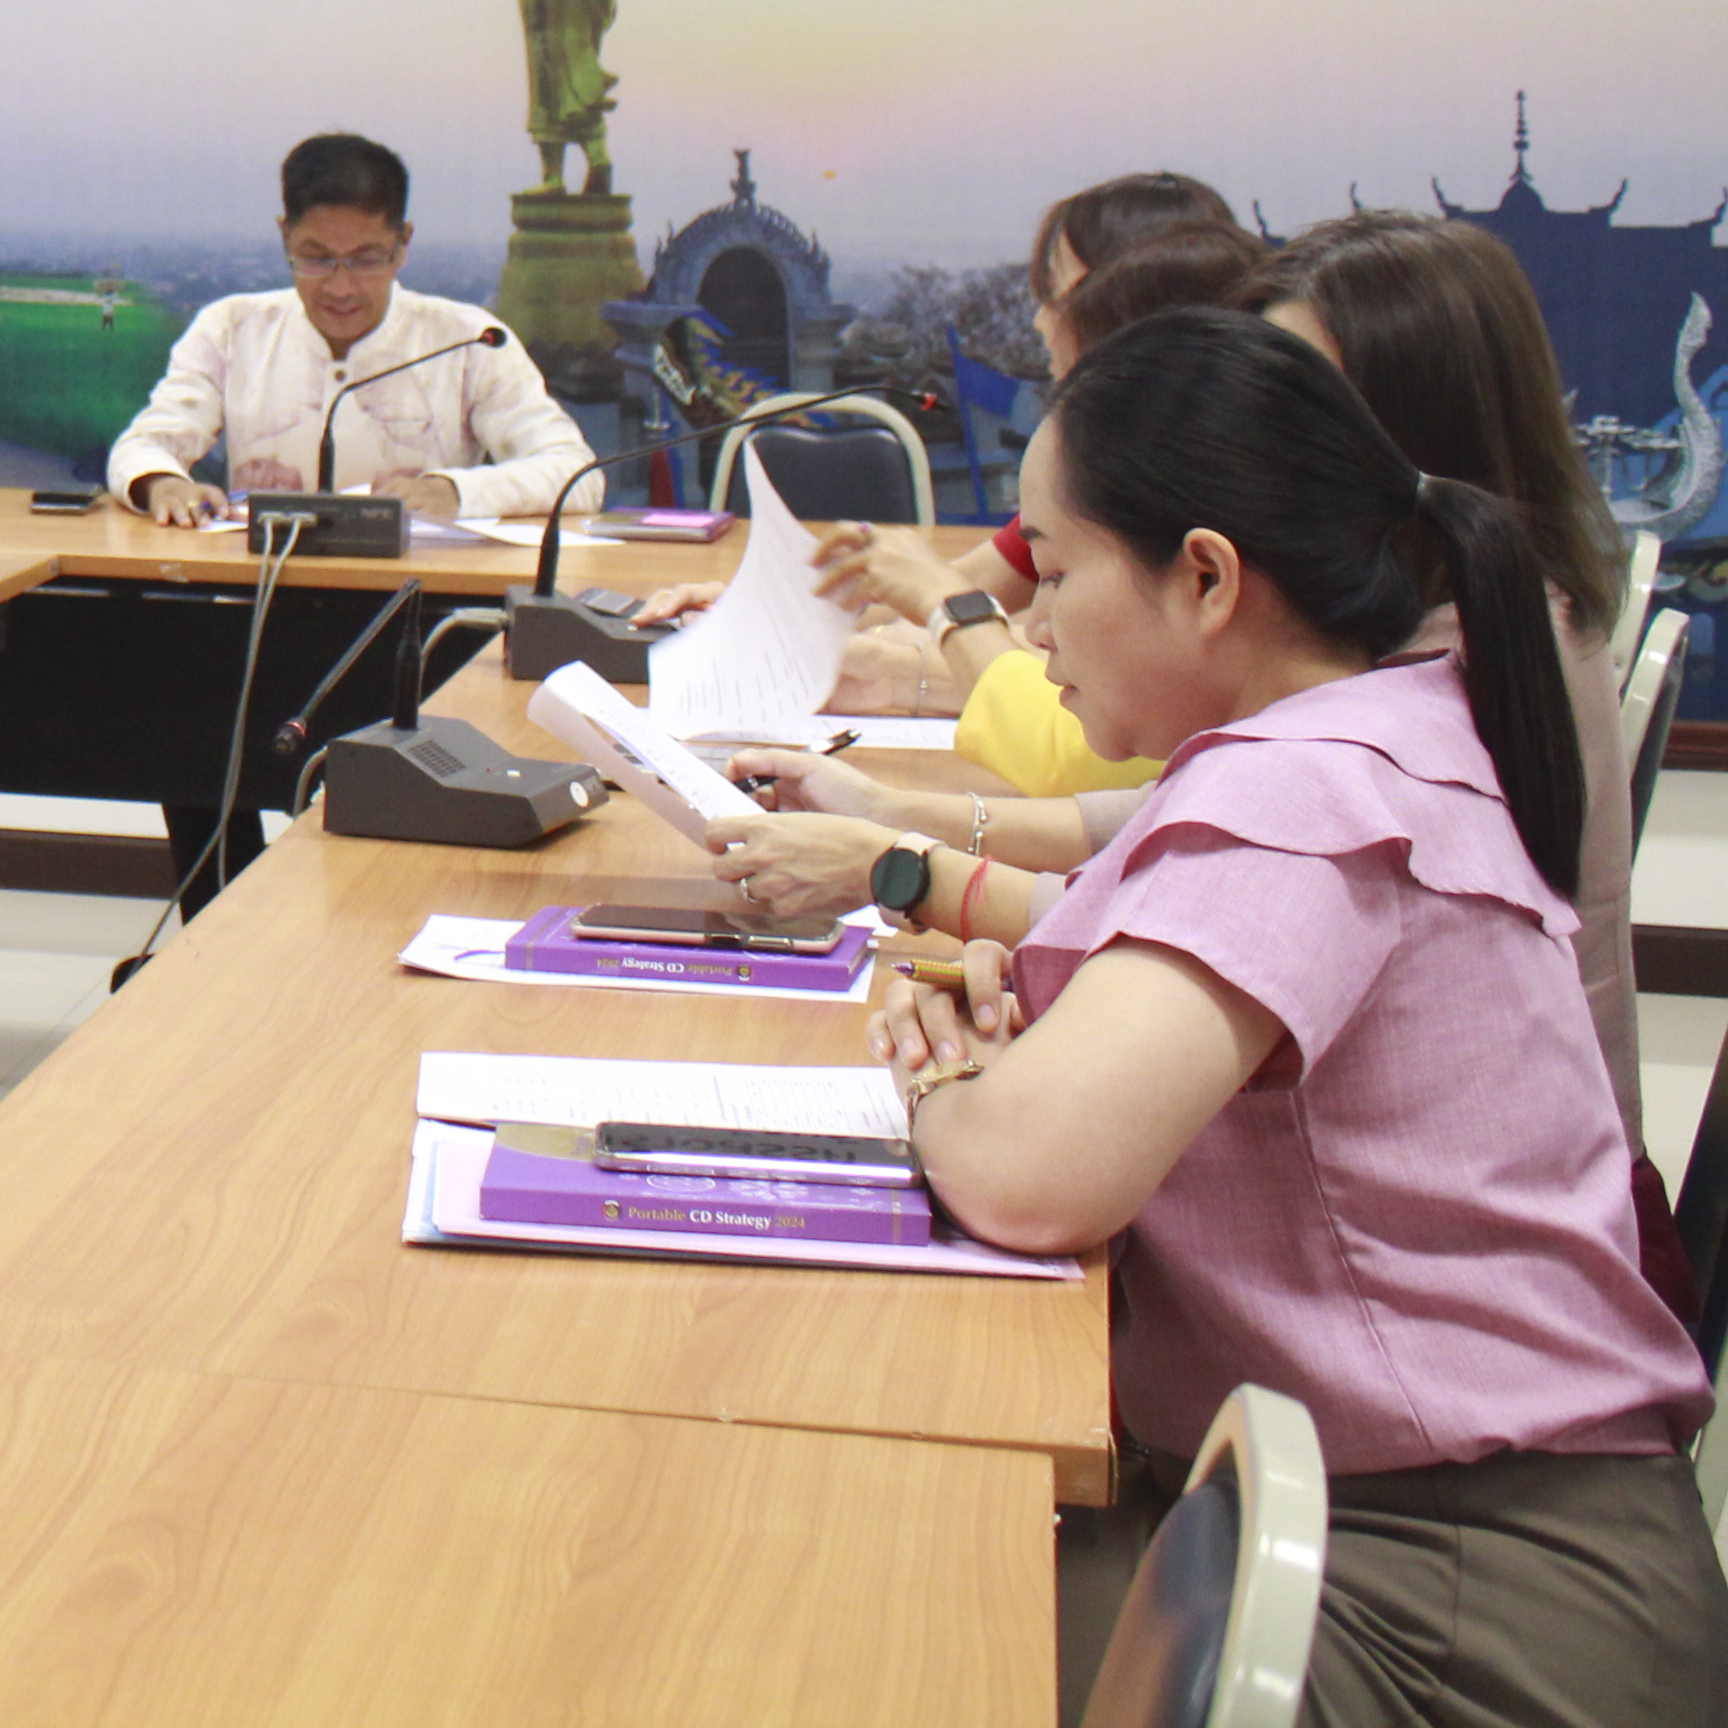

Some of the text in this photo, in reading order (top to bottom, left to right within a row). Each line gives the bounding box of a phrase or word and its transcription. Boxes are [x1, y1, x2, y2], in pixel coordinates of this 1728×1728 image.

[621, 956, 665, 973] Strategy
[666, 962, 685, 974] CD
[628, 1206, 806, 1229] Portable CD Strategy 2024
